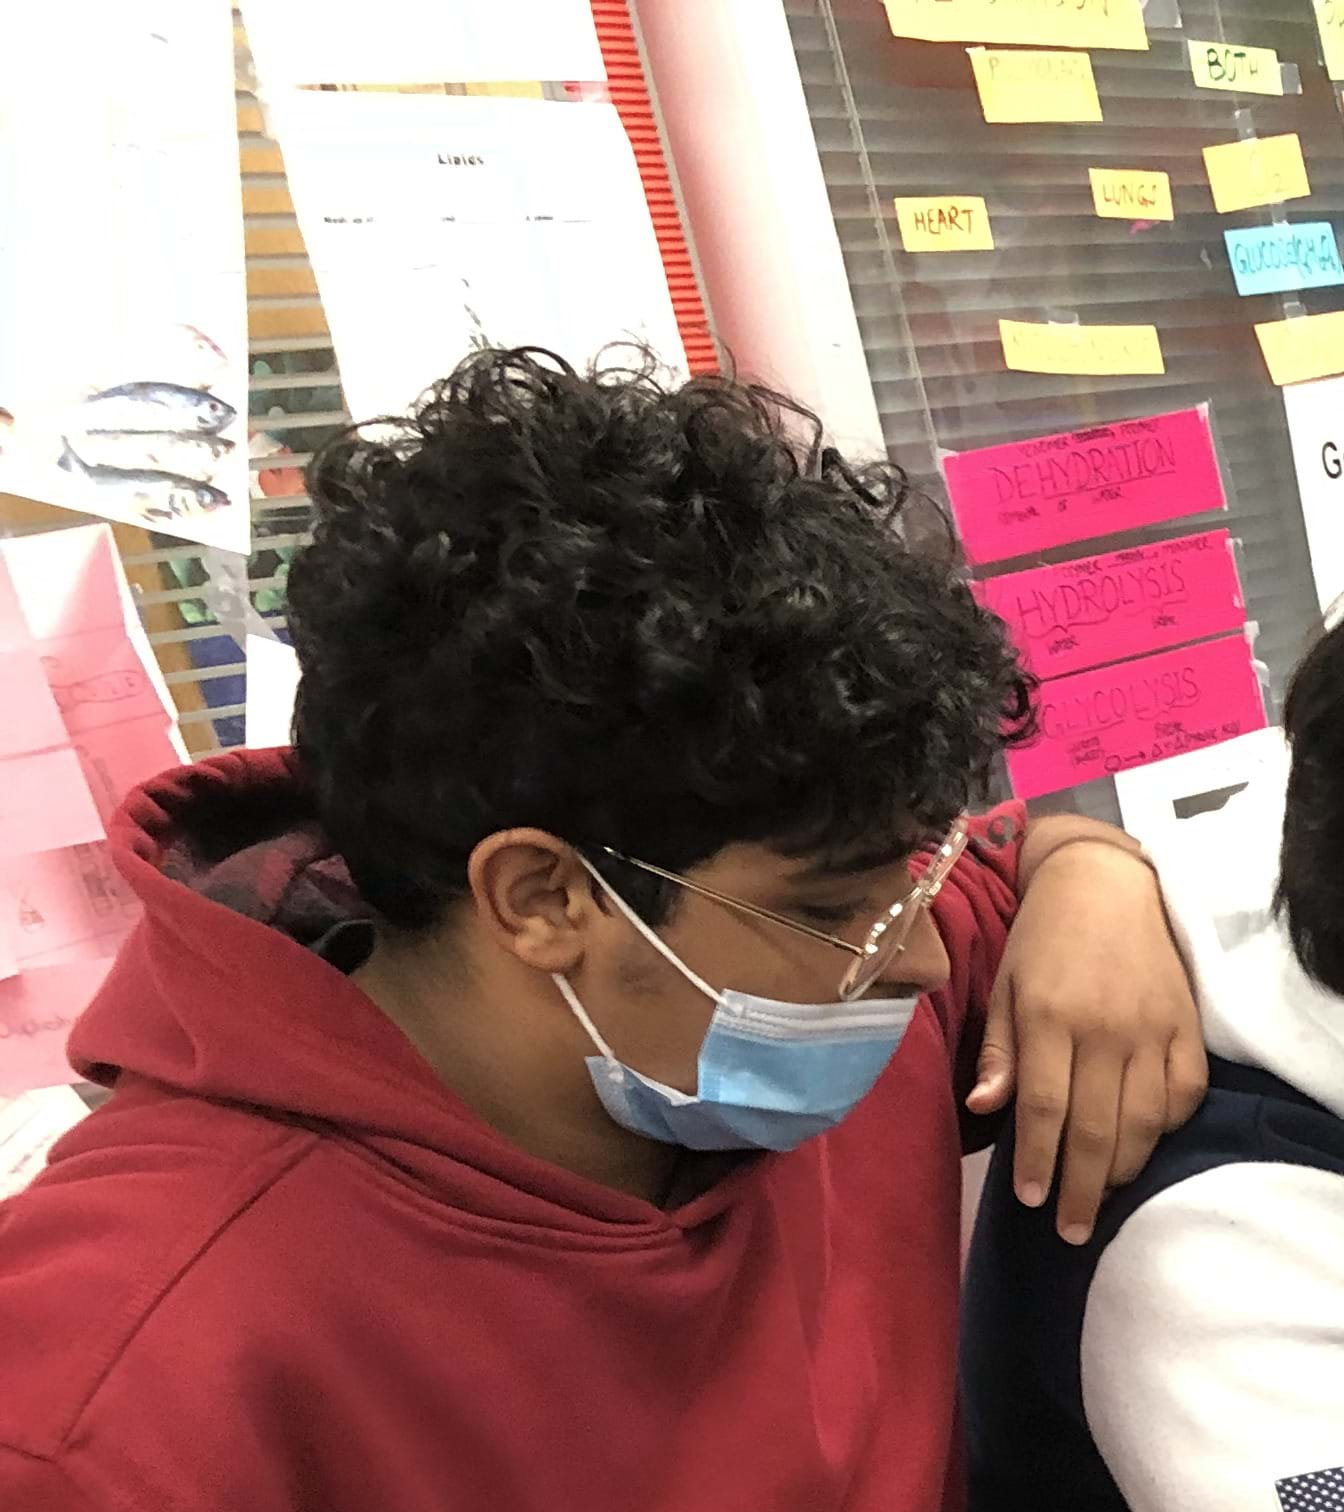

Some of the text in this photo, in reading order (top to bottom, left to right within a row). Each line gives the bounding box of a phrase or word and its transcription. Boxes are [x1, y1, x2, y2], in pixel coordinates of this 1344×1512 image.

[914, 208, 974, 235] HEART
[1103, 182, 1158, 207] LUNGS
[989, 436, 1176, 501] DEHYDRATION
[1016, 558, 1187, 630] HYDROLYSIS
[1041, 667, 1200, 735] GLYCOLYSIS
